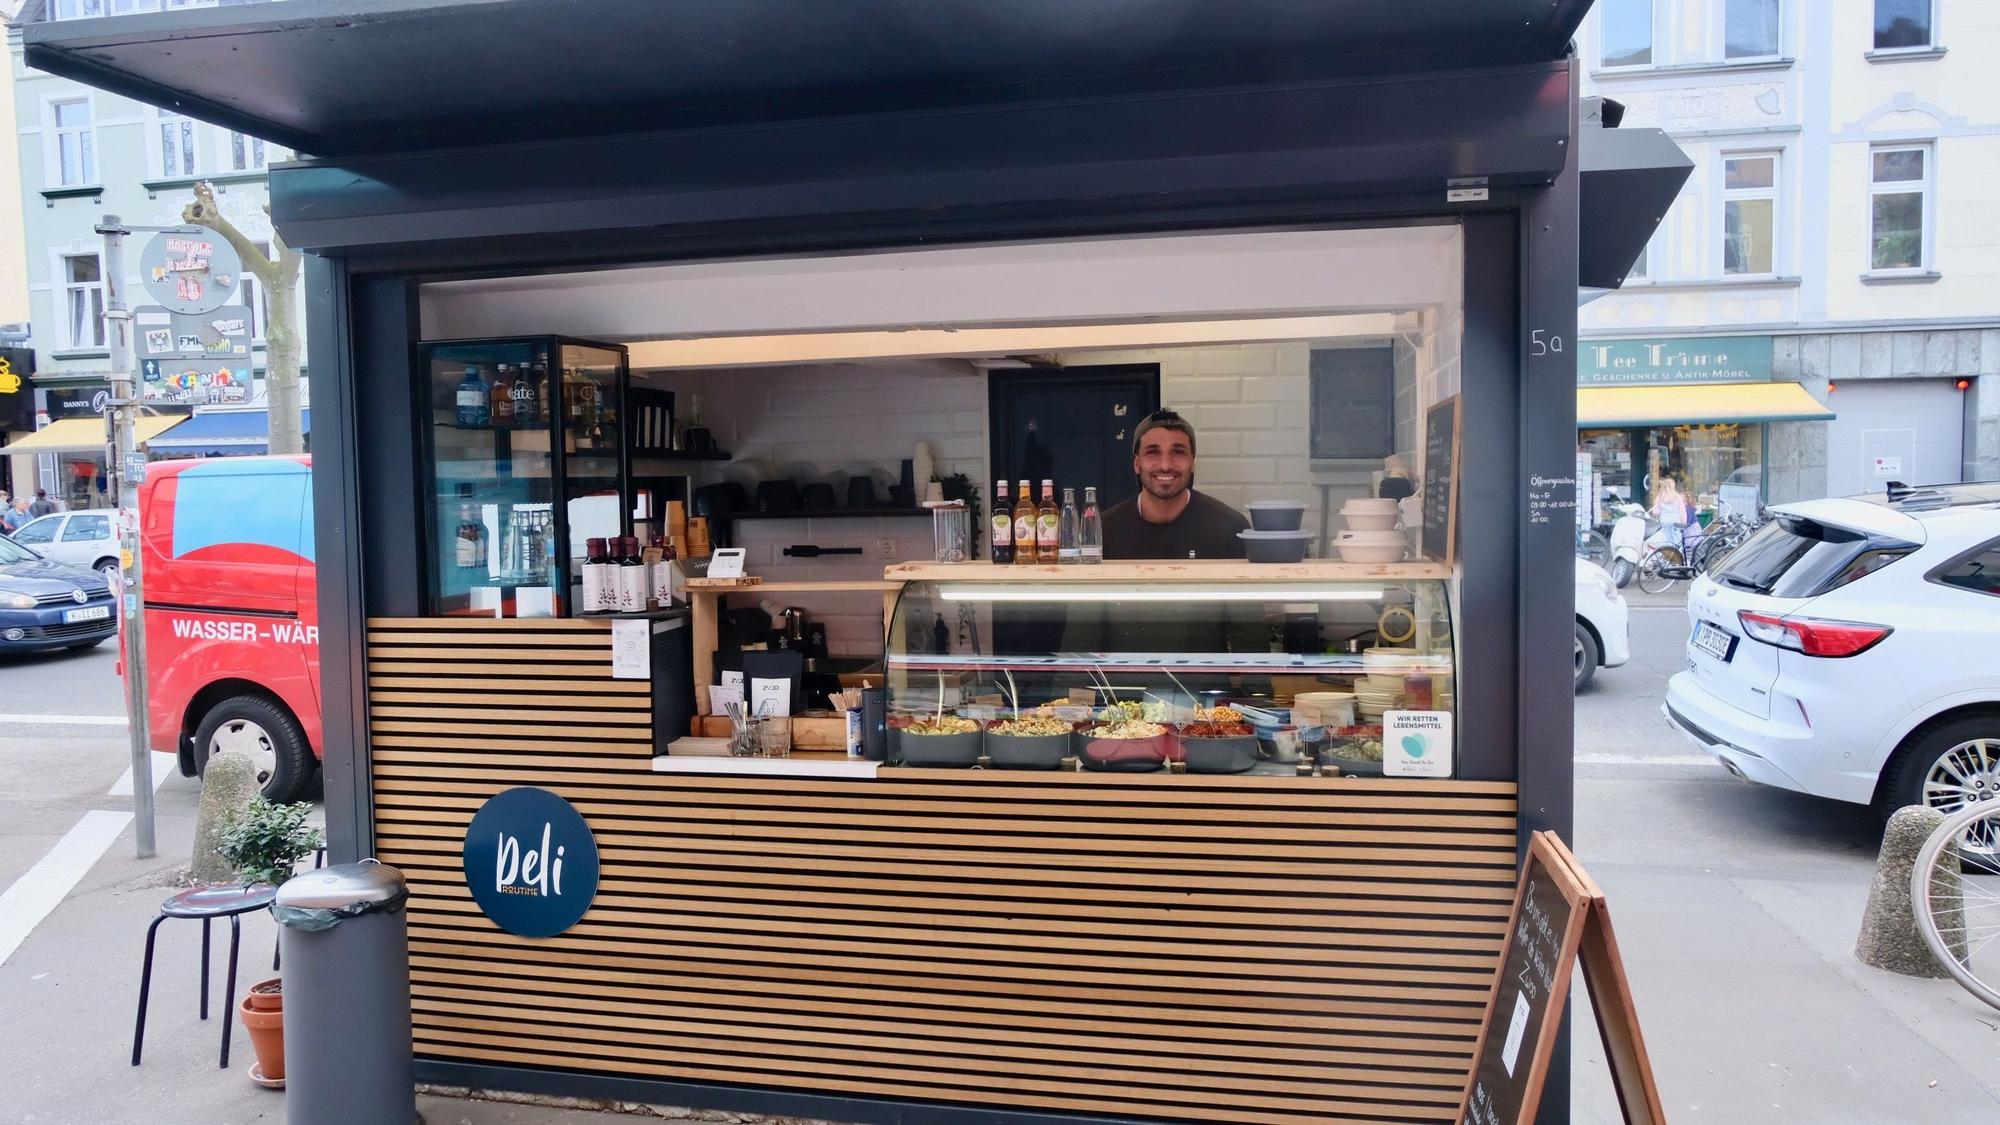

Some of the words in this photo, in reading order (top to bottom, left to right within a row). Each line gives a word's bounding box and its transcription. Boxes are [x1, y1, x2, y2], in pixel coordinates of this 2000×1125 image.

[1531, 329, 1562, 356] 5a
[1590, 345, 1636, 369] Tee
[496, 821, 565, 897] Deli
